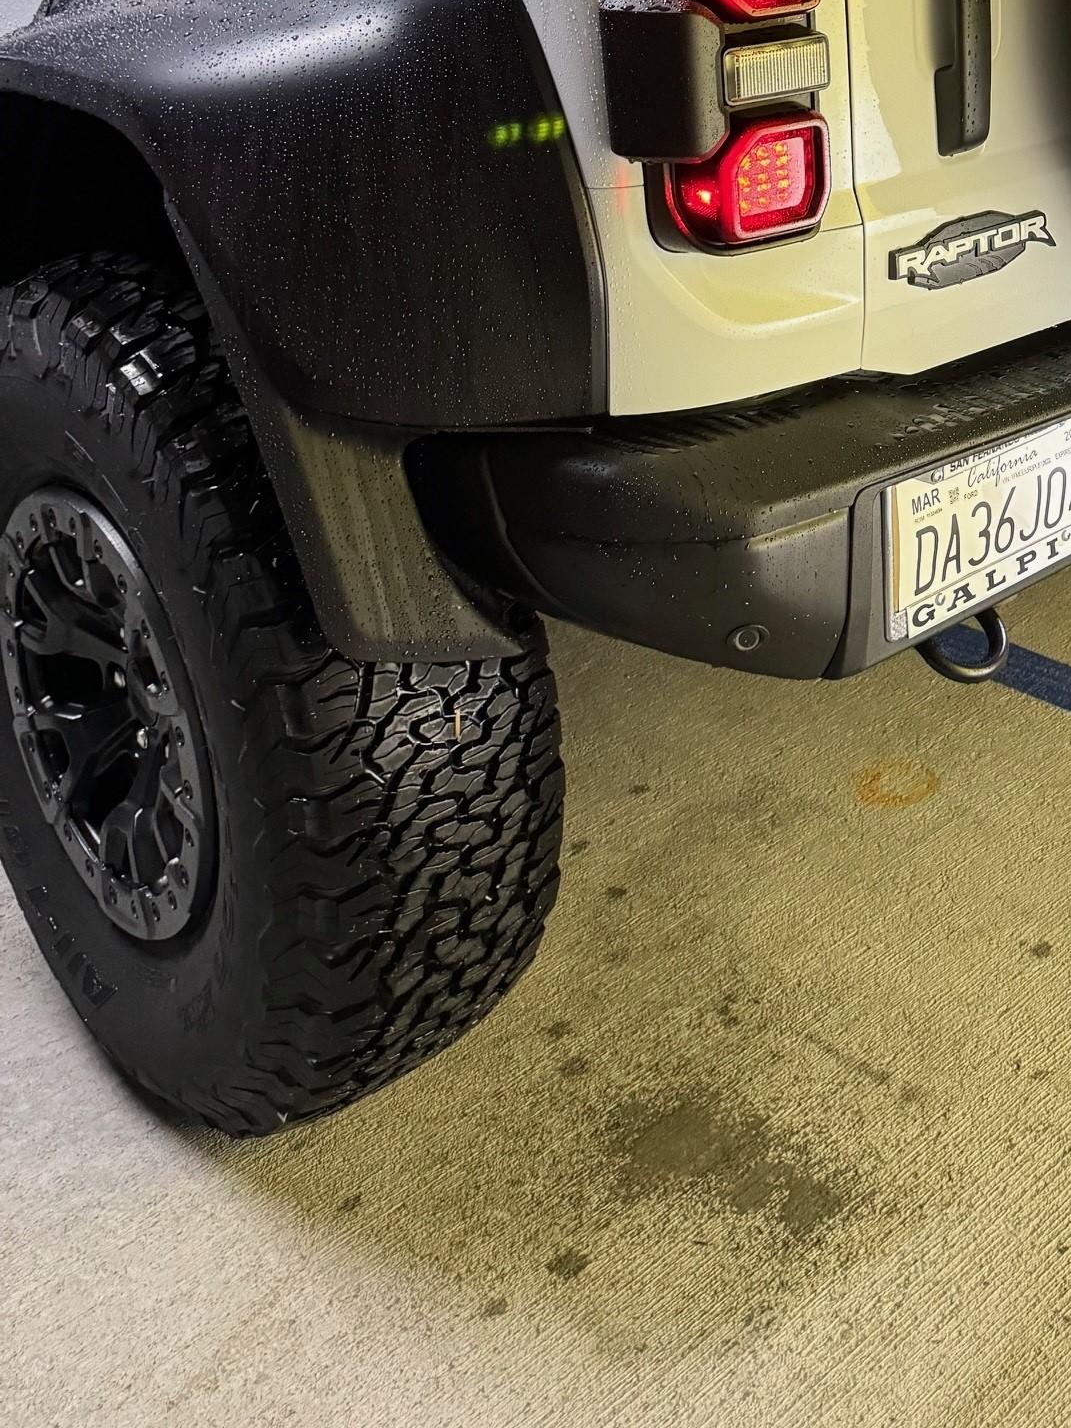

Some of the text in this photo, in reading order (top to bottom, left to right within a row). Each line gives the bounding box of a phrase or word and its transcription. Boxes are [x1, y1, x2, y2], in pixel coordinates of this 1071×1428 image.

[898, 214, 1052, 279] RAPTOR
[949, 456, 970, 473] SAN
[967, 447, 1039, 489] California
[911, 488, 942, 515] MAR
